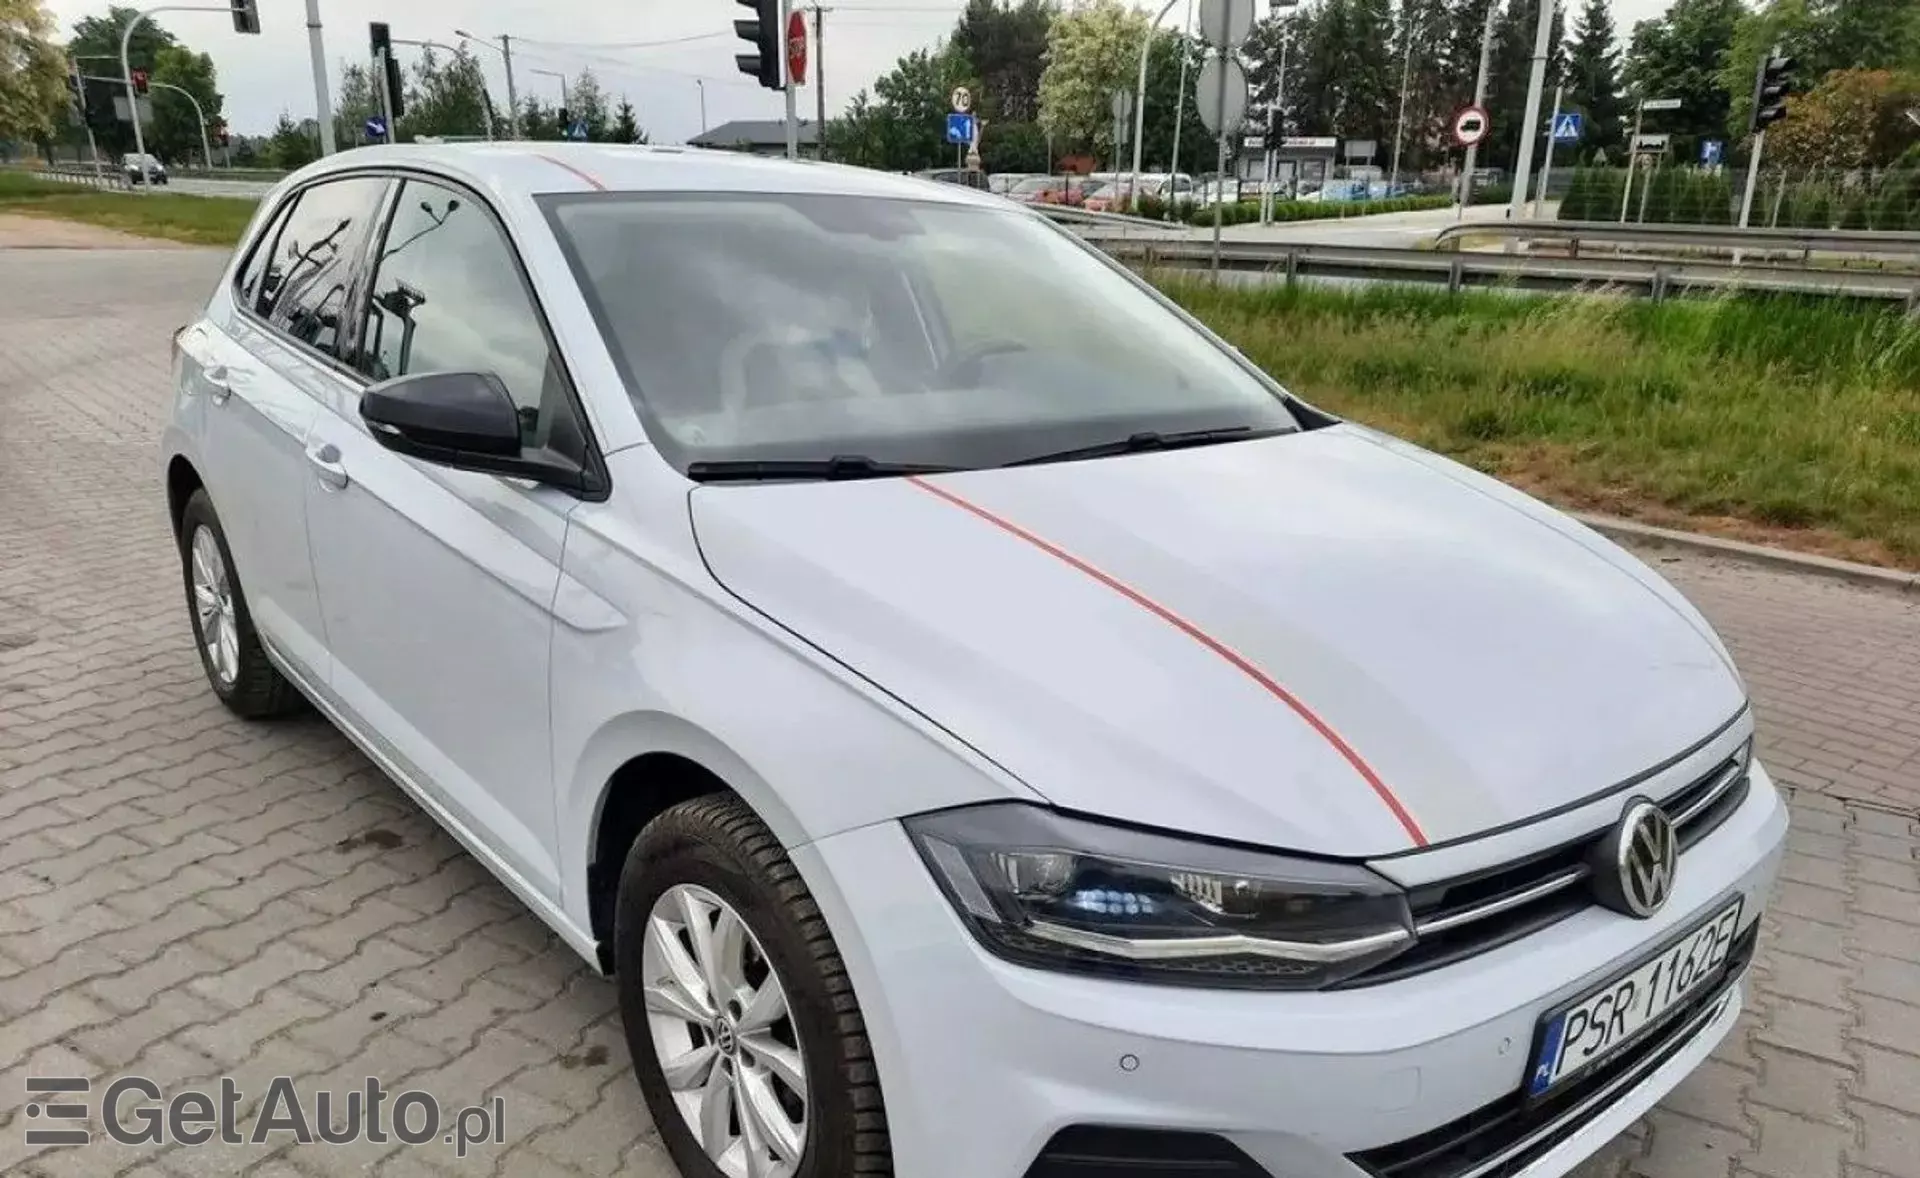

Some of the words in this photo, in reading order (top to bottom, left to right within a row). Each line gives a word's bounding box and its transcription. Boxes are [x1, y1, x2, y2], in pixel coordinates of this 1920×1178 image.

[955, 91, 970, 107] 70
[1555, 980, 1634, 1076] PSR
[1645, 911, 1738, 1019] 1162E
